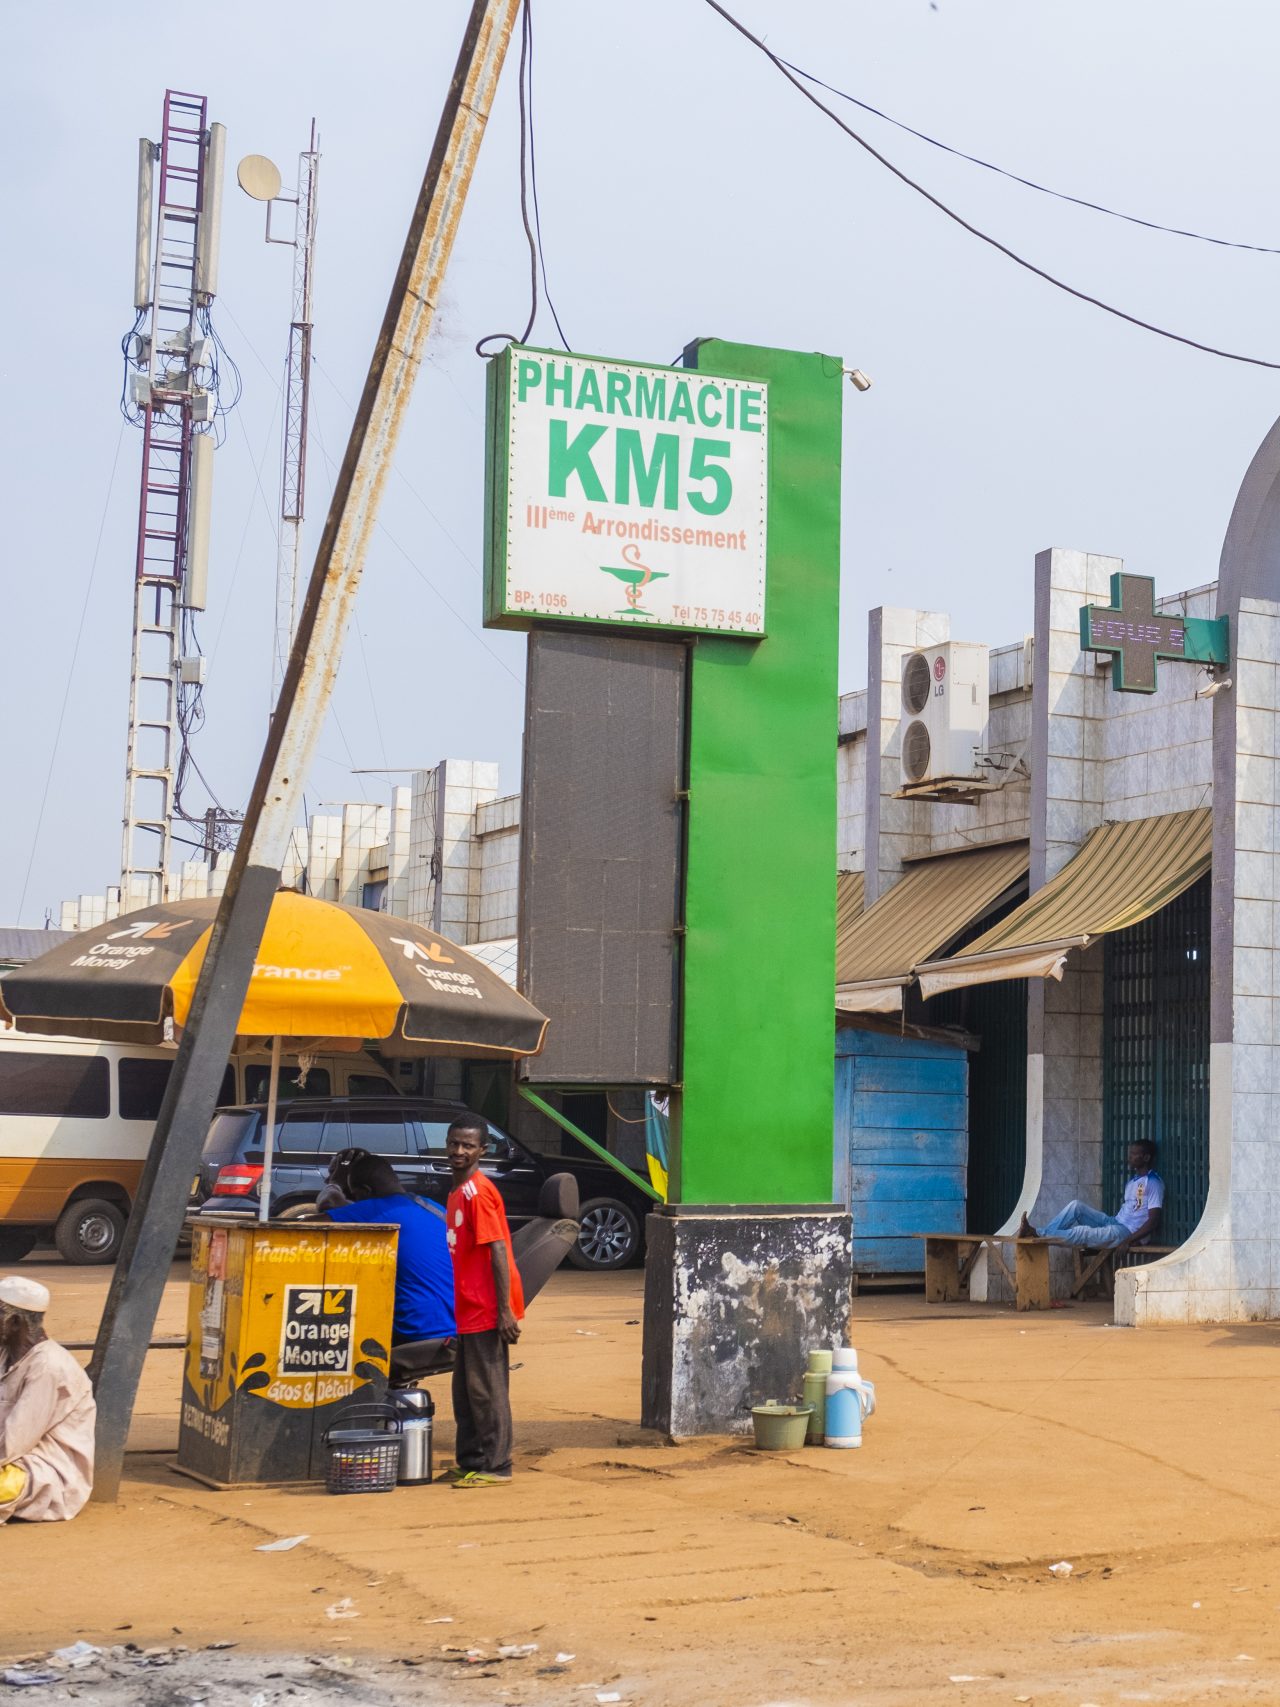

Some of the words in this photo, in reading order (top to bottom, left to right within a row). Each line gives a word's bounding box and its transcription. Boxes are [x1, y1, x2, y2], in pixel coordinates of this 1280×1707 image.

[517, 358, 762, 433] PHARMACIE
[547, 417, 734, 516] KM5
[582, 511, 747, 551] Arrondissement
[514, 590, 535, 604] BP:
[539, 591, 568, 608] 1056
[694, 606, 708, 621] 75
[711, 608, 725, 622] 75
[728, 610, 742, 624] 45
[745, 611, 759, 625] 40
[934, 684, 945, 698] LG
[88, 943, 156, 958] Orange
[69, 954, 135, 970] Money
[251, 964, 342, 981] range
[414, 963, 476, 985] Orange
[430, 976, 483, 1000] Money
[330, 1243, 349, 1264] de
[286, 1320, 350, 1345] Orange
[285, 1345, 349, 1369] Money
[267, 1380, 302, 1402] Gros
[303, 1382, 315, 1403] &
[316, 1379, 355, 1402] Détail
